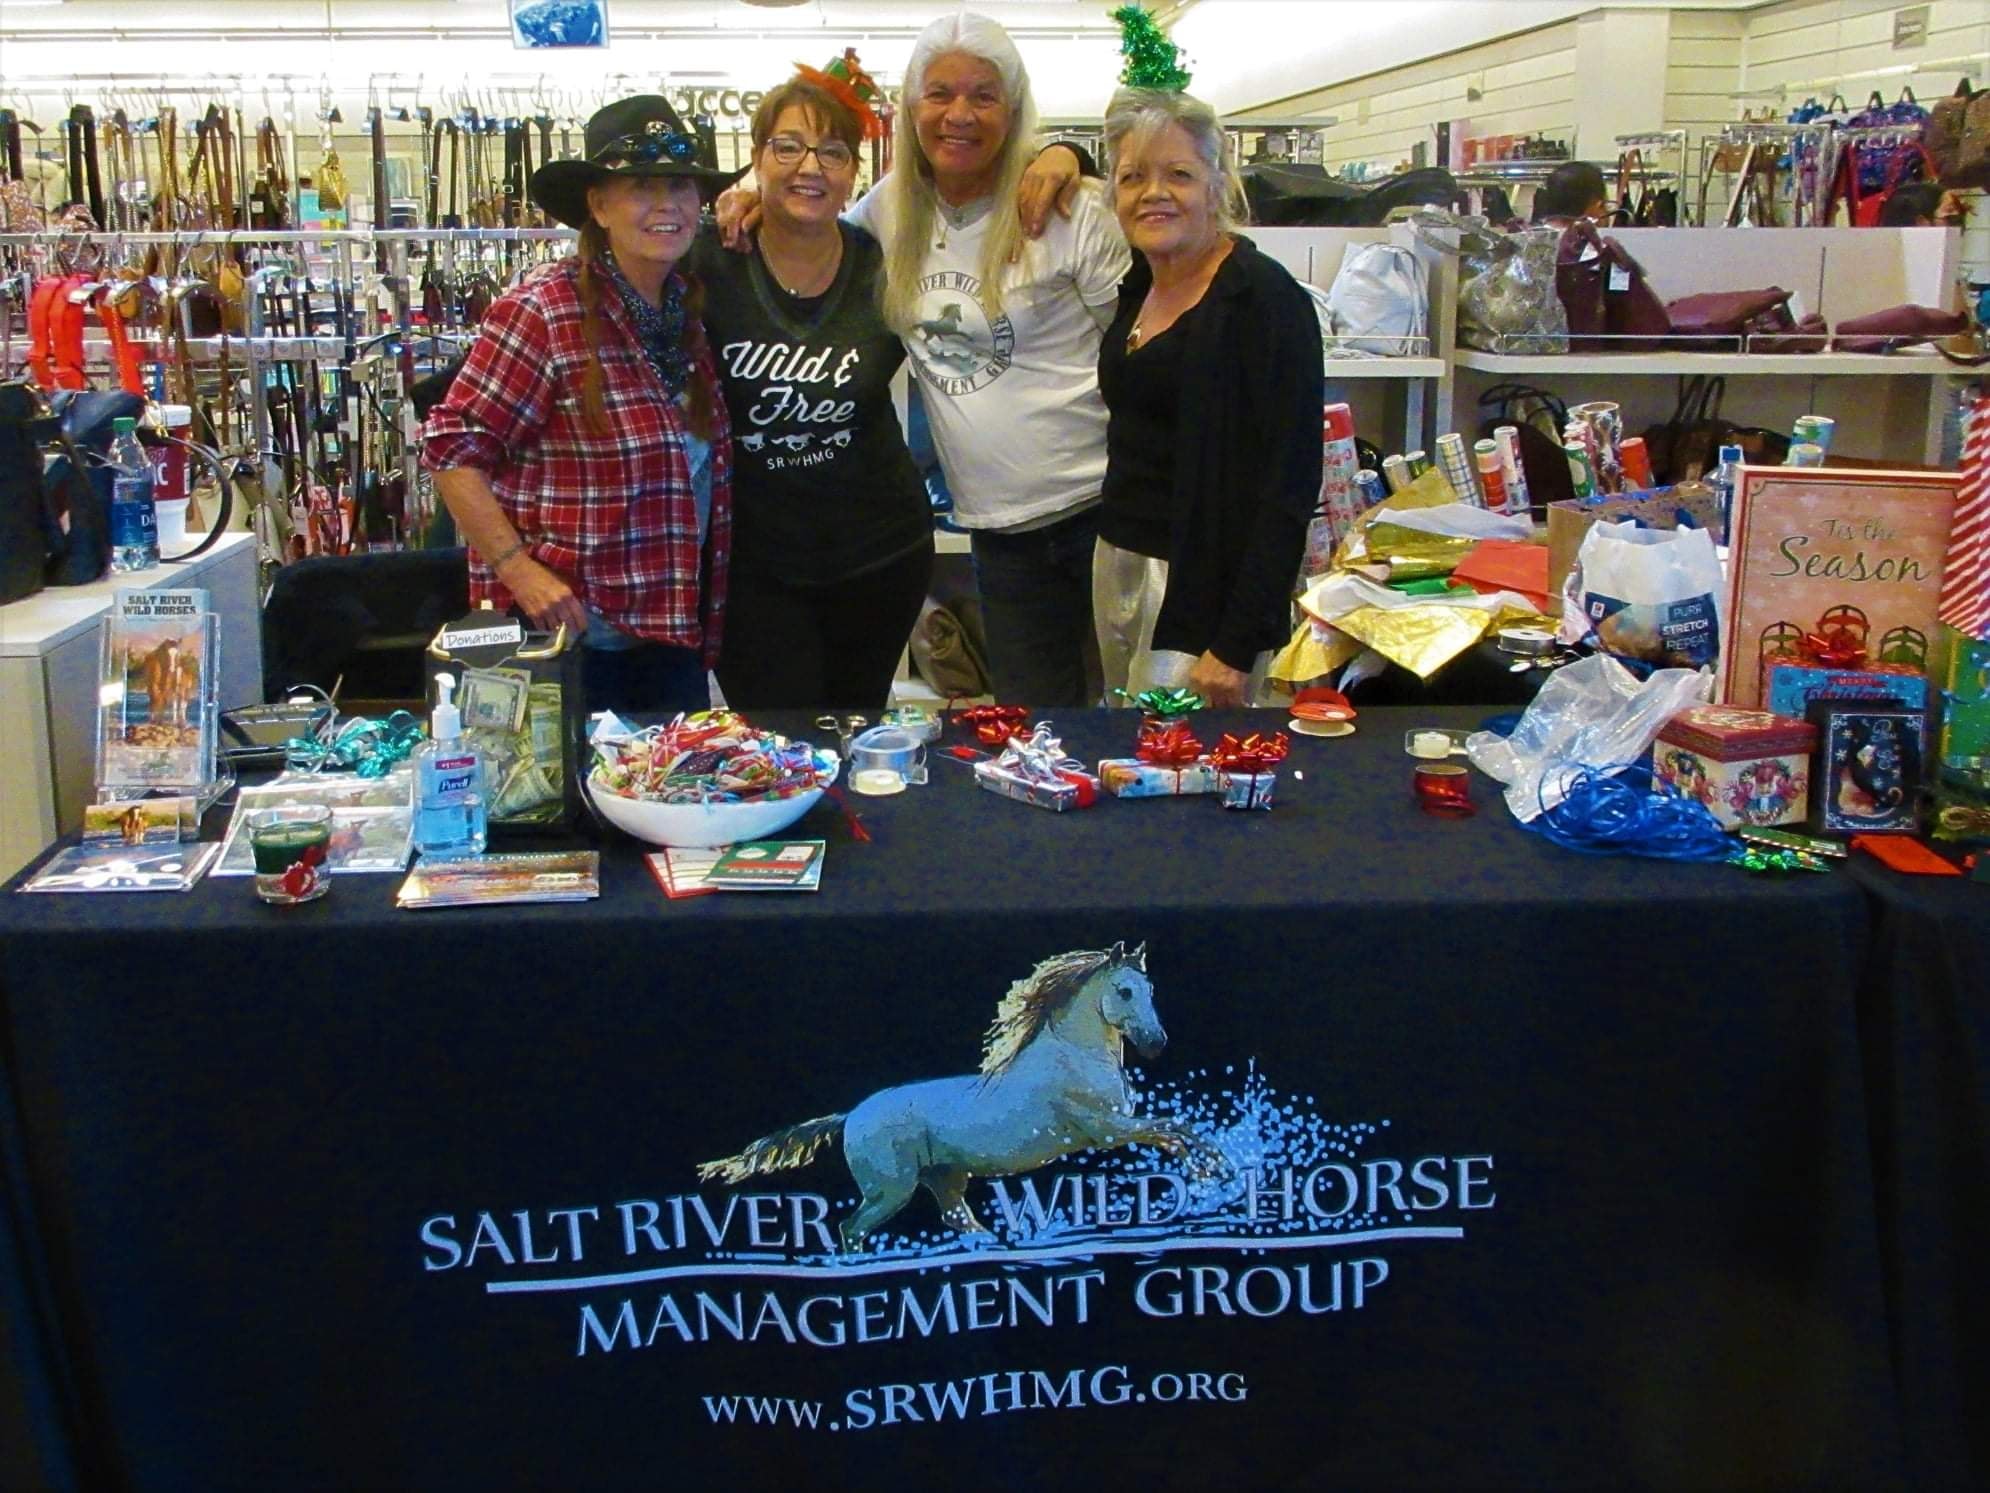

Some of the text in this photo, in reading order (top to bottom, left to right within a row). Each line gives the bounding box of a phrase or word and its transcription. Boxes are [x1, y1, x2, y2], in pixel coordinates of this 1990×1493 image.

[722, 341, 860, 388] Wild &
[749, 385, 856, 426] Free
[767, 449, 835, 470] SRWHMG
[1770, 536, 1932, 582] Season
[128, 595, 192, 605] SALT RIVER
[123, 606, 196, 616] WILD HORSES
[1663, 618, 1709, 636] STRETCH
[446, 630, 516, 648] Donations
[1666, 633, 1709, 650] REPEAT
[418, 1153, 1498, 1272] SALT RIVER WILD HORSE
[576, 1257, 1390, 1357] MANAGEMENT GROUP
